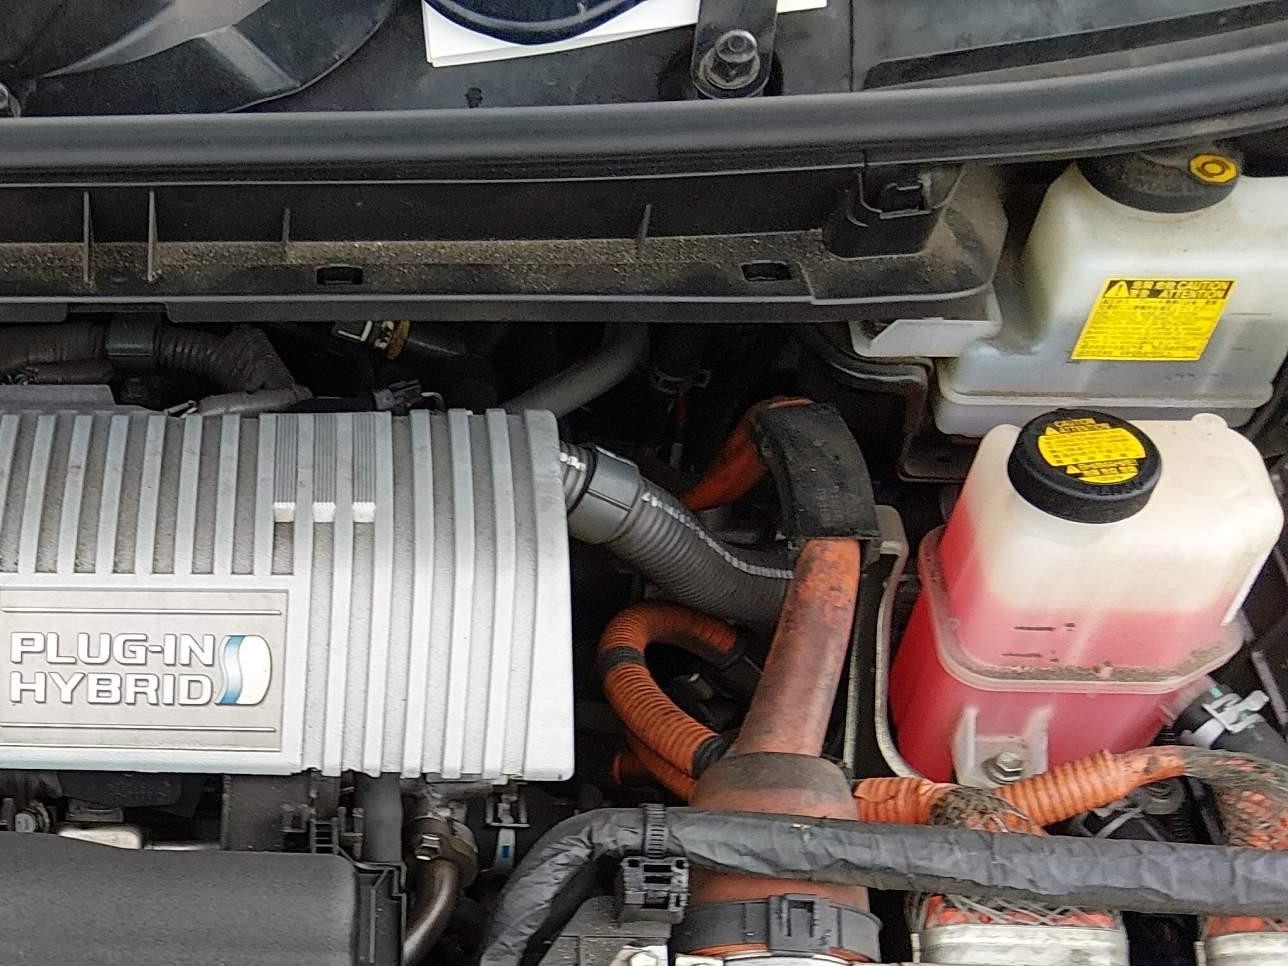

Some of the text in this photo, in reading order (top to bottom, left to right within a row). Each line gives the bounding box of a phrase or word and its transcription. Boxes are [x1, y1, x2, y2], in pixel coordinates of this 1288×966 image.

[1177, 281, 1231, 290] CAUTION
[10, 632, 215, 666] PLUG-IN
[10, 671, 213, 706] HYBRID
